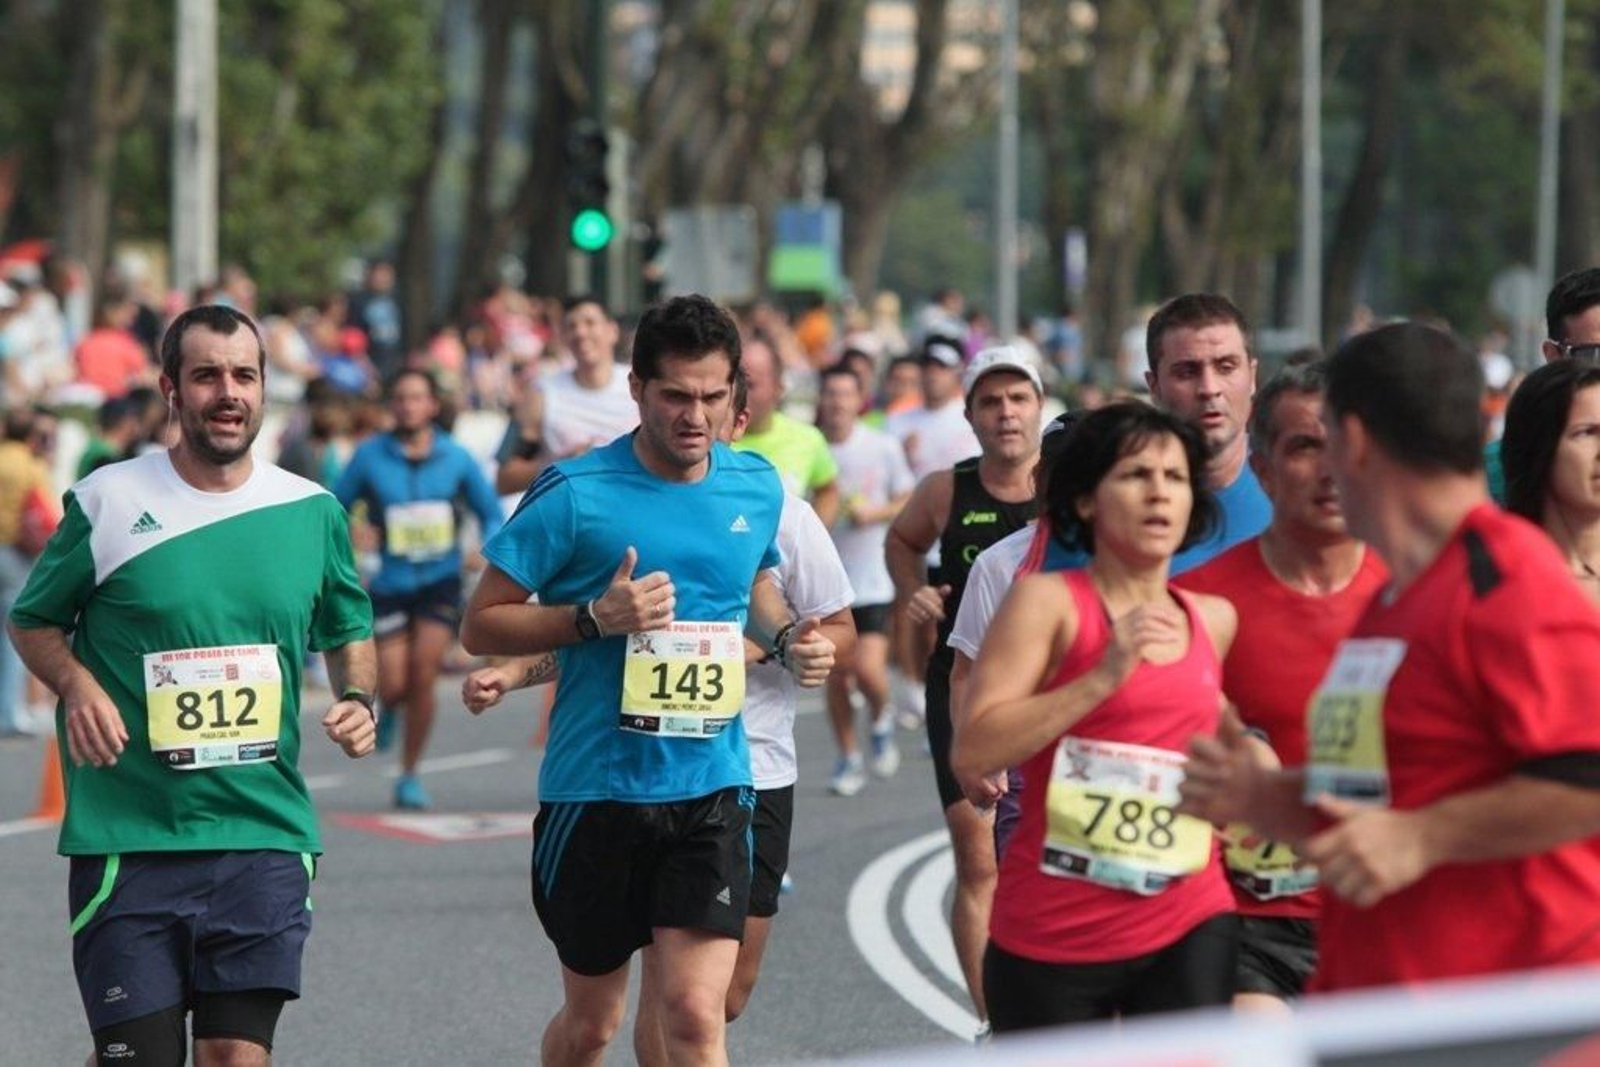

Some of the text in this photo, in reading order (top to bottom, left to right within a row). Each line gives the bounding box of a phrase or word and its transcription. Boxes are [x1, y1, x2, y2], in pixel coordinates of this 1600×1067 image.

[649, 661, 724, 702] 143
[175, 686, 259, 731] 812
[1082, 793, 1175, 850] 788
